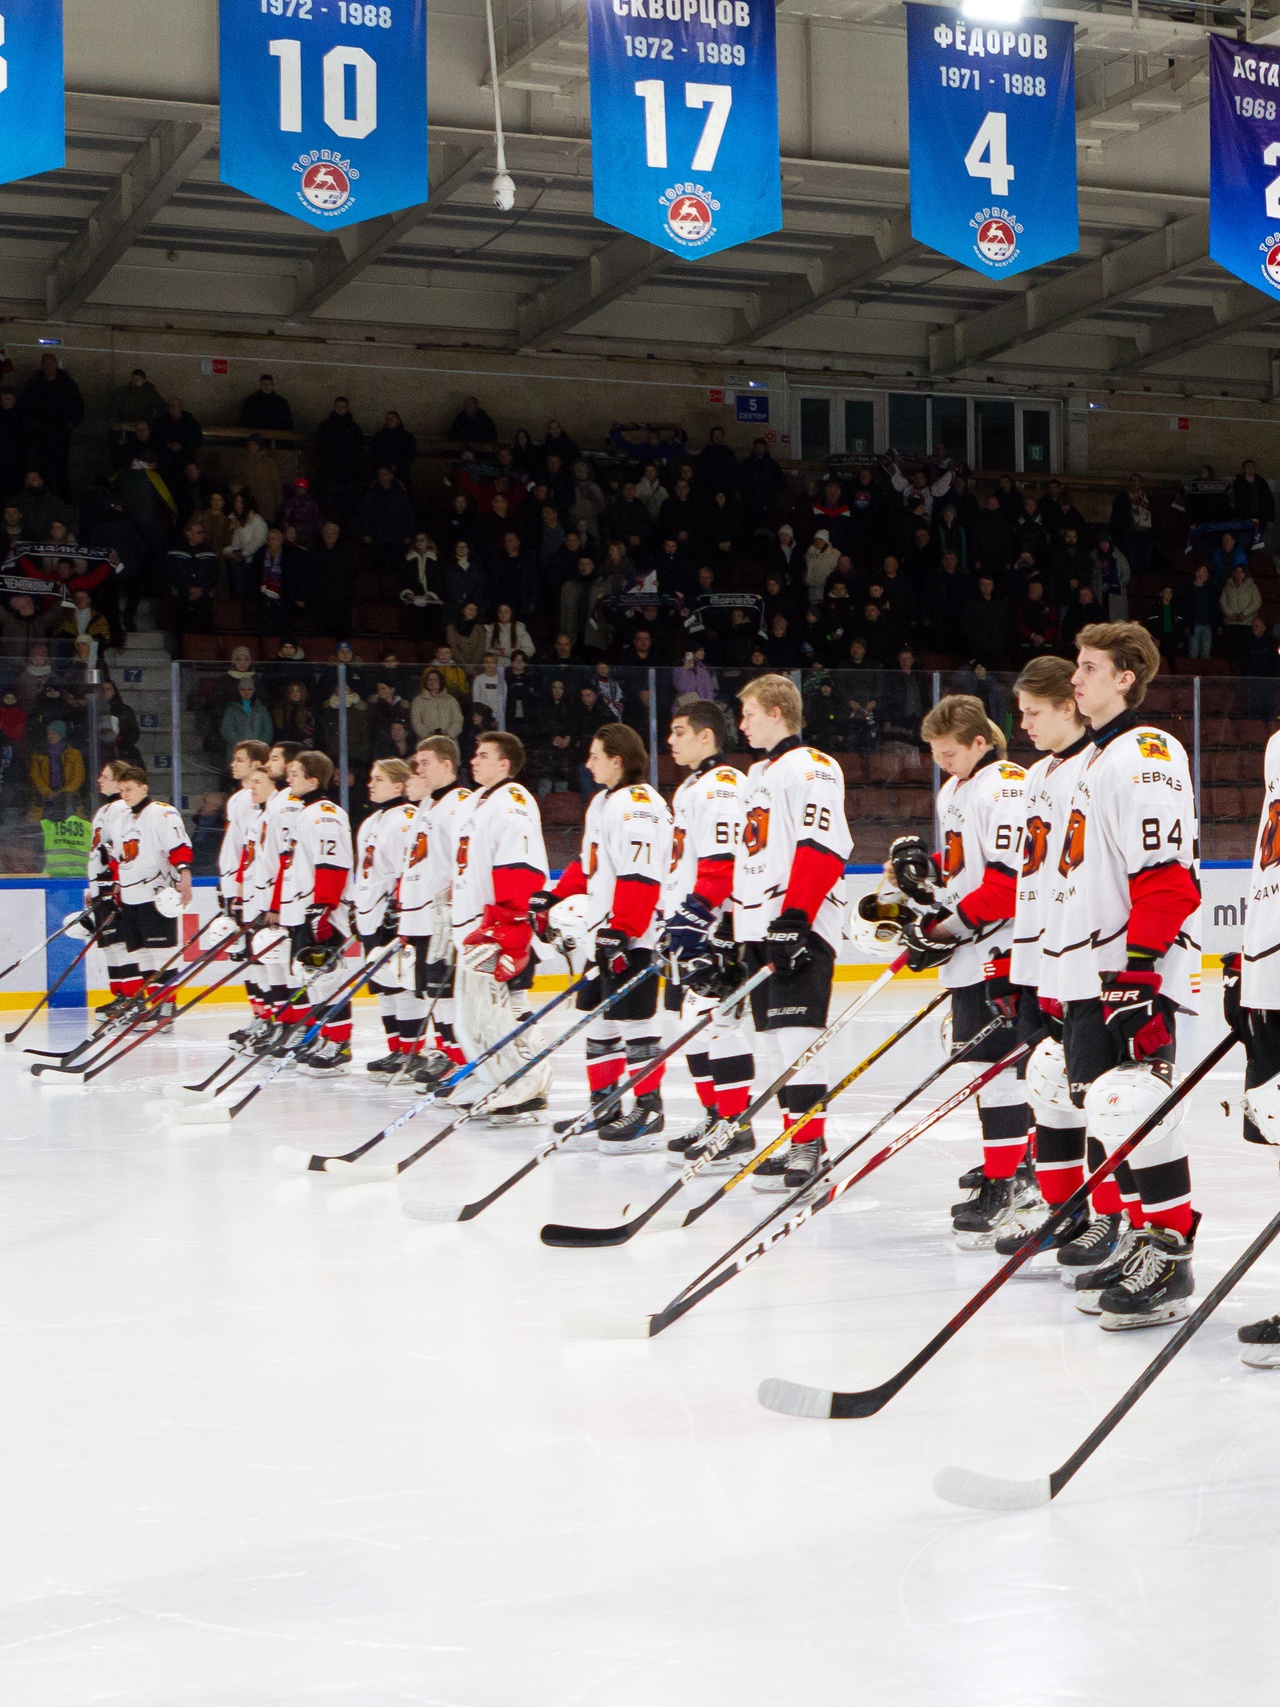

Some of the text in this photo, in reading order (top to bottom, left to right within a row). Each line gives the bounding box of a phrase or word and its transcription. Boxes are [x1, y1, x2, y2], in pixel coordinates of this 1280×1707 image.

[261, 0, 312, 20] 1972
[340, 1, 392, 28] 1988
[613, 0, 751, 29] СКВОРЦОВ
[624, 35, 674, 60] 1972
[698, 41, 746, 66] 1989
[933, 20, 1048, 60] ФЁДОРОВ
[269, 38, 378, 139] 10
[939, 66, 981, 91] 1971
[1003, 72, 1046, 97] 1988
[1234, 95, 1276, 121] 1968
[634, 79, 732, 172] 17
[291, 149, 360, 180] ТОРПЕДО
[964, 112, 1015, 197] 4
[658, 182, 721, 211] ТОРПЕДО
[969, 206, 1024, 234] ТОРПЕДО
[738, 412, 767, 420] СЕКТОР
[749, 398, 758, 411] 5
[159, 757, 167, 766] 5
[803, 803, 831, 832] 86
[320, 839, 336, 855] 12
[995, 824, 1024, 853] 61
[1142, 817, 1183, 851] 84
[631, 840, 651, 864] 71
[682, 1119, 741, 1184] BAUER
[737, 1204, 813, 1271] CCM
